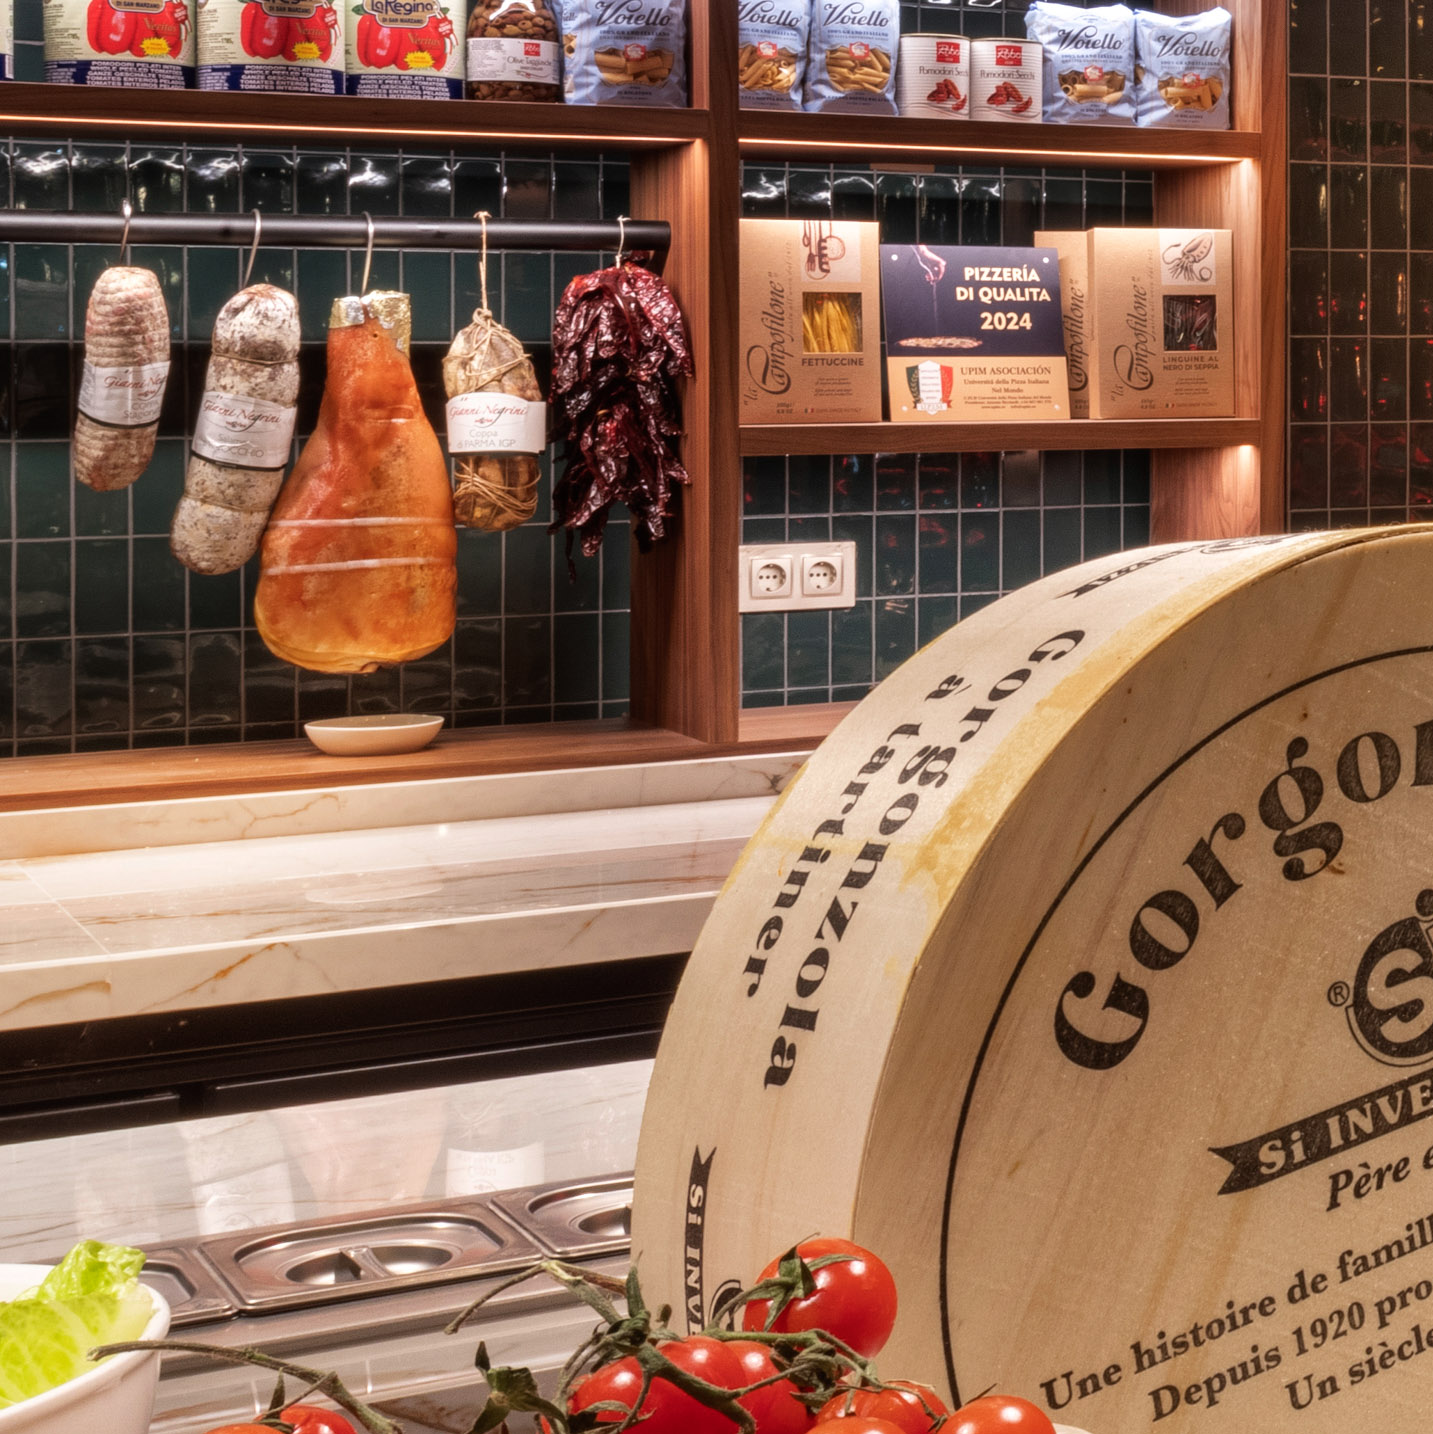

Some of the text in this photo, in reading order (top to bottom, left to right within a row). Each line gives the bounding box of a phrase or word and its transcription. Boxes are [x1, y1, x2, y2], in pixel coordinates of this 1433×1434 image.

[823, 2, 889, 27] Voiello
[1057, 25, 1124, 52] Voiello
[1156, 31, 1221, 58] Voiello
[919, 66, 953, 76] Pomodori
[964, 264, 1041, 282] PIZZERÍA
[956, 287, 1051, 304] DI QUALITA
[980, 312, 1032, 330] 2024
[802, 357, 865, 367] FETTUCCINE
[960, 365, 1051, 375] UPIM ASOCIACIÓN
[449, 403, 529, 420] Gianni Negrini
[464, 440, 496, 448] PARMA
[498, 439, 517, 447] IGP
[469, 429, 498, 438] Coppa
[742, 674, 972, 998] à tartiner
[764, 628, 1086, 1090] Gorgonzola
[1257, 1132, 1309, 1174] Si
[1326, 1154, 1410, 1211] Père
[1039, 1363, 1123, 1411] Une
[1130, 1294, 1277, 1375] histoire
[1287, 1269, 1328, 1304] de
[1148, 1344, 1282, 1422] Depuis
[1291, 1301, 1366, 1357] 1920
[1285, 1373, 1341, 1411] Un
